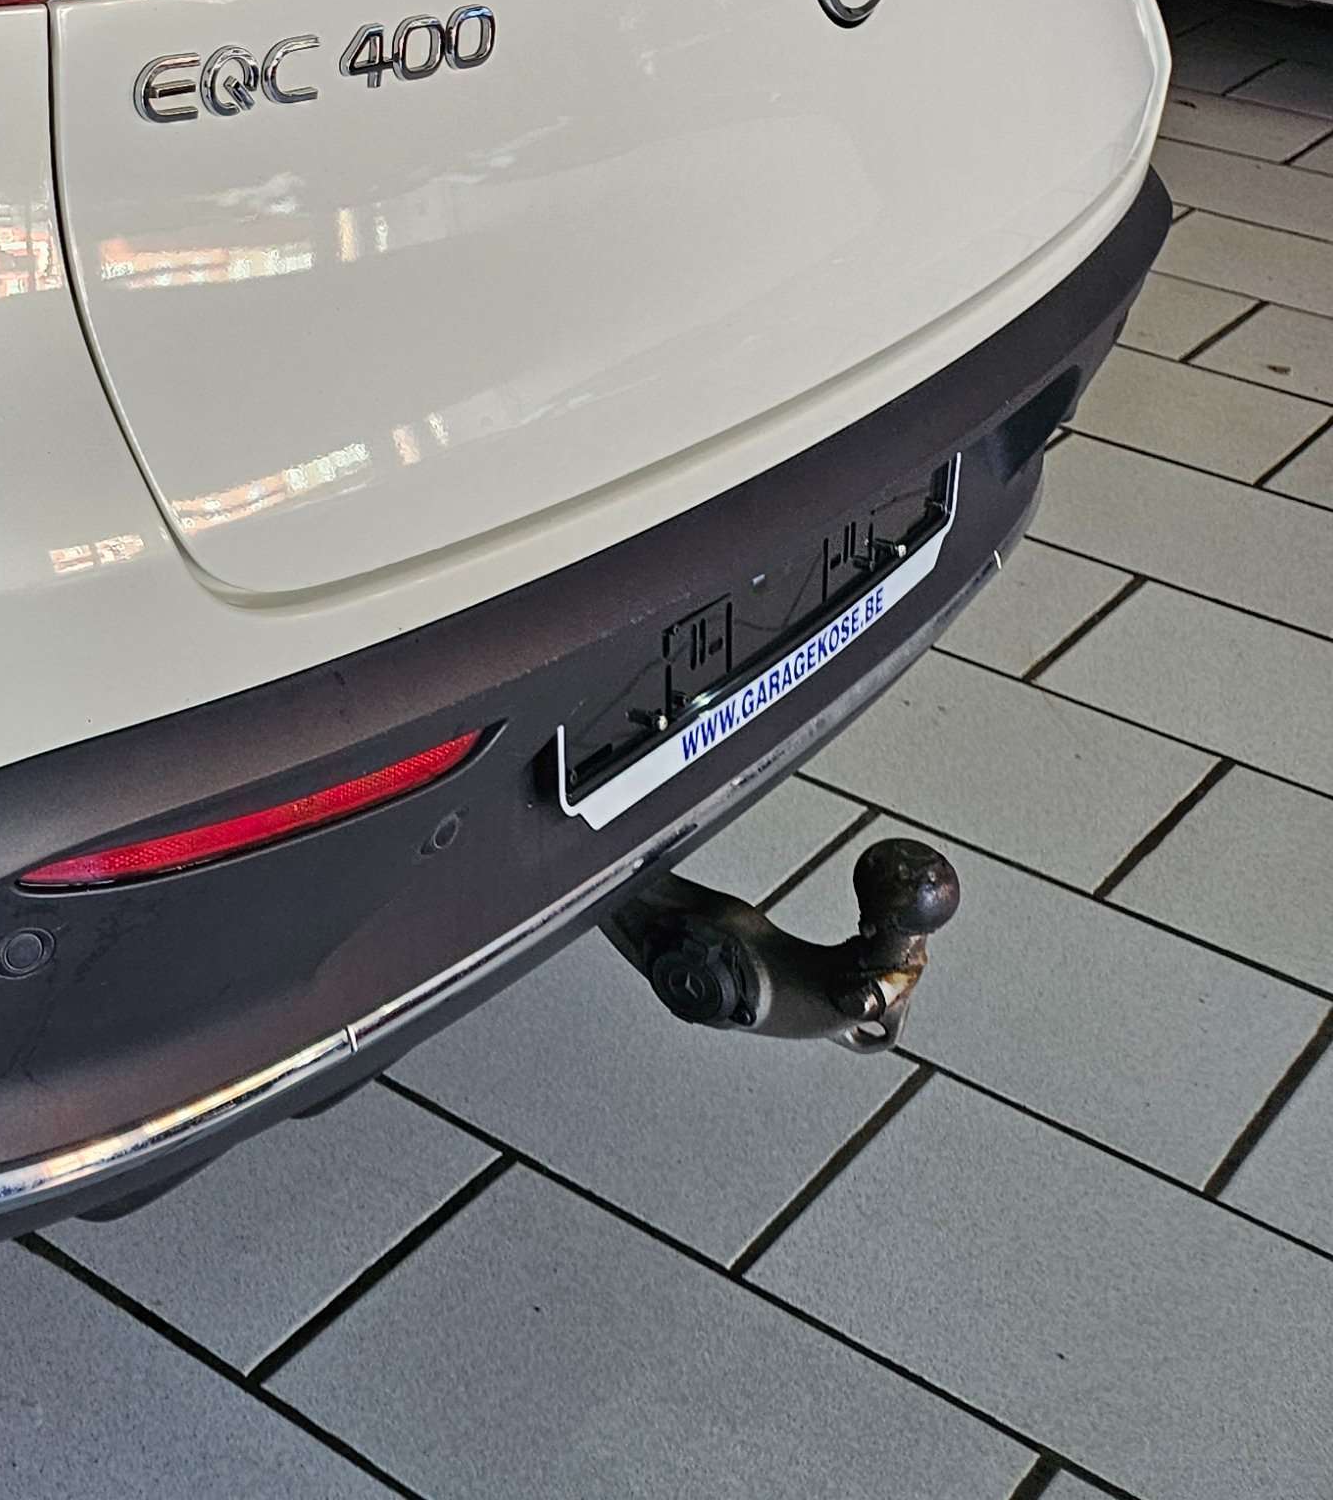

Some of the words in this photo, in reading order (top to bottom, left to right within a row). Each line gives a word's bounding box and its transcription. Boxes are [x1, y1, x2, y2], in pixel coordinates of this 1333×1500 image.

[134, 34, 320, 124] EQC
[339, 3, 496, 89] 400
[681, 586, 885, 762] WWW.GARAGEKOSE.BE
